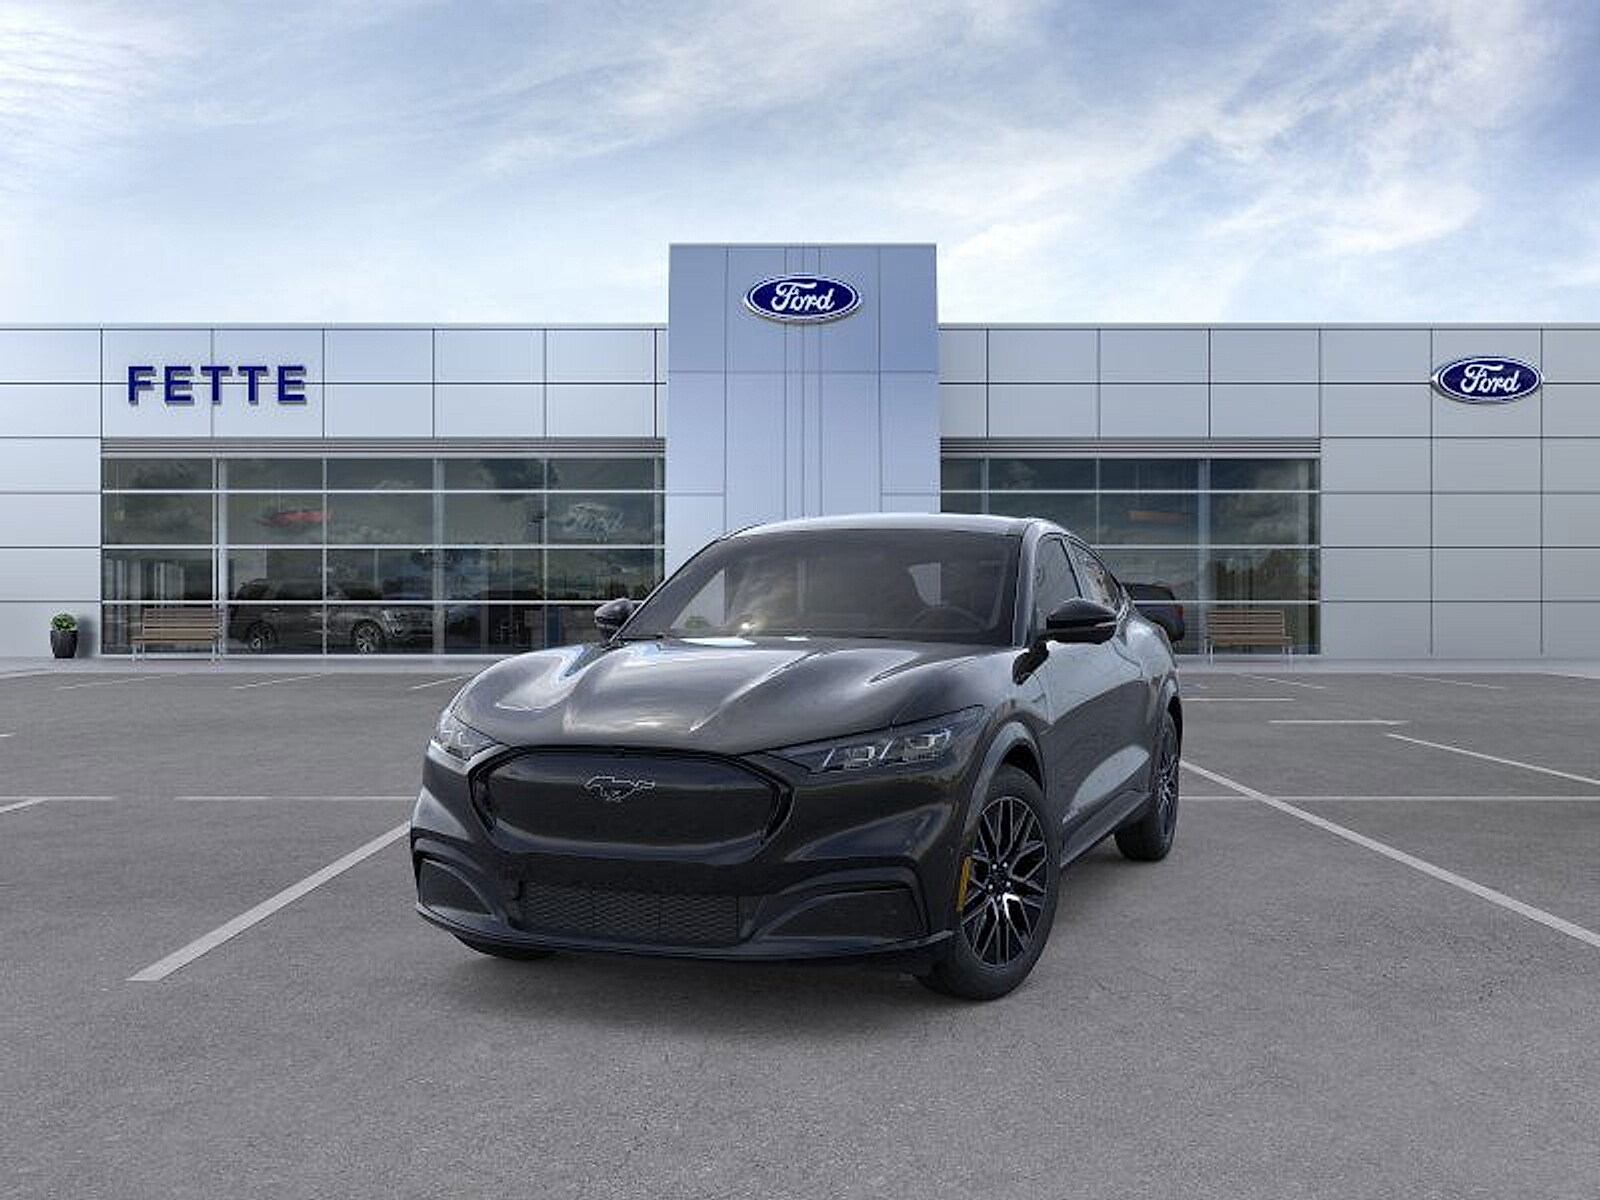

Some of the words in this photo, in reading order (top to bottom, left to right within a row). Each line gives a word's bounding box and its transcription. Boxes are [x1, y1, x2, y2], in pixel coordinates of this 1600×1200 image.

[771, 282, 835, 311] Ford
[127, 365, 306, 404] FETTE
[1460, 364, 1521, 393] Ford
